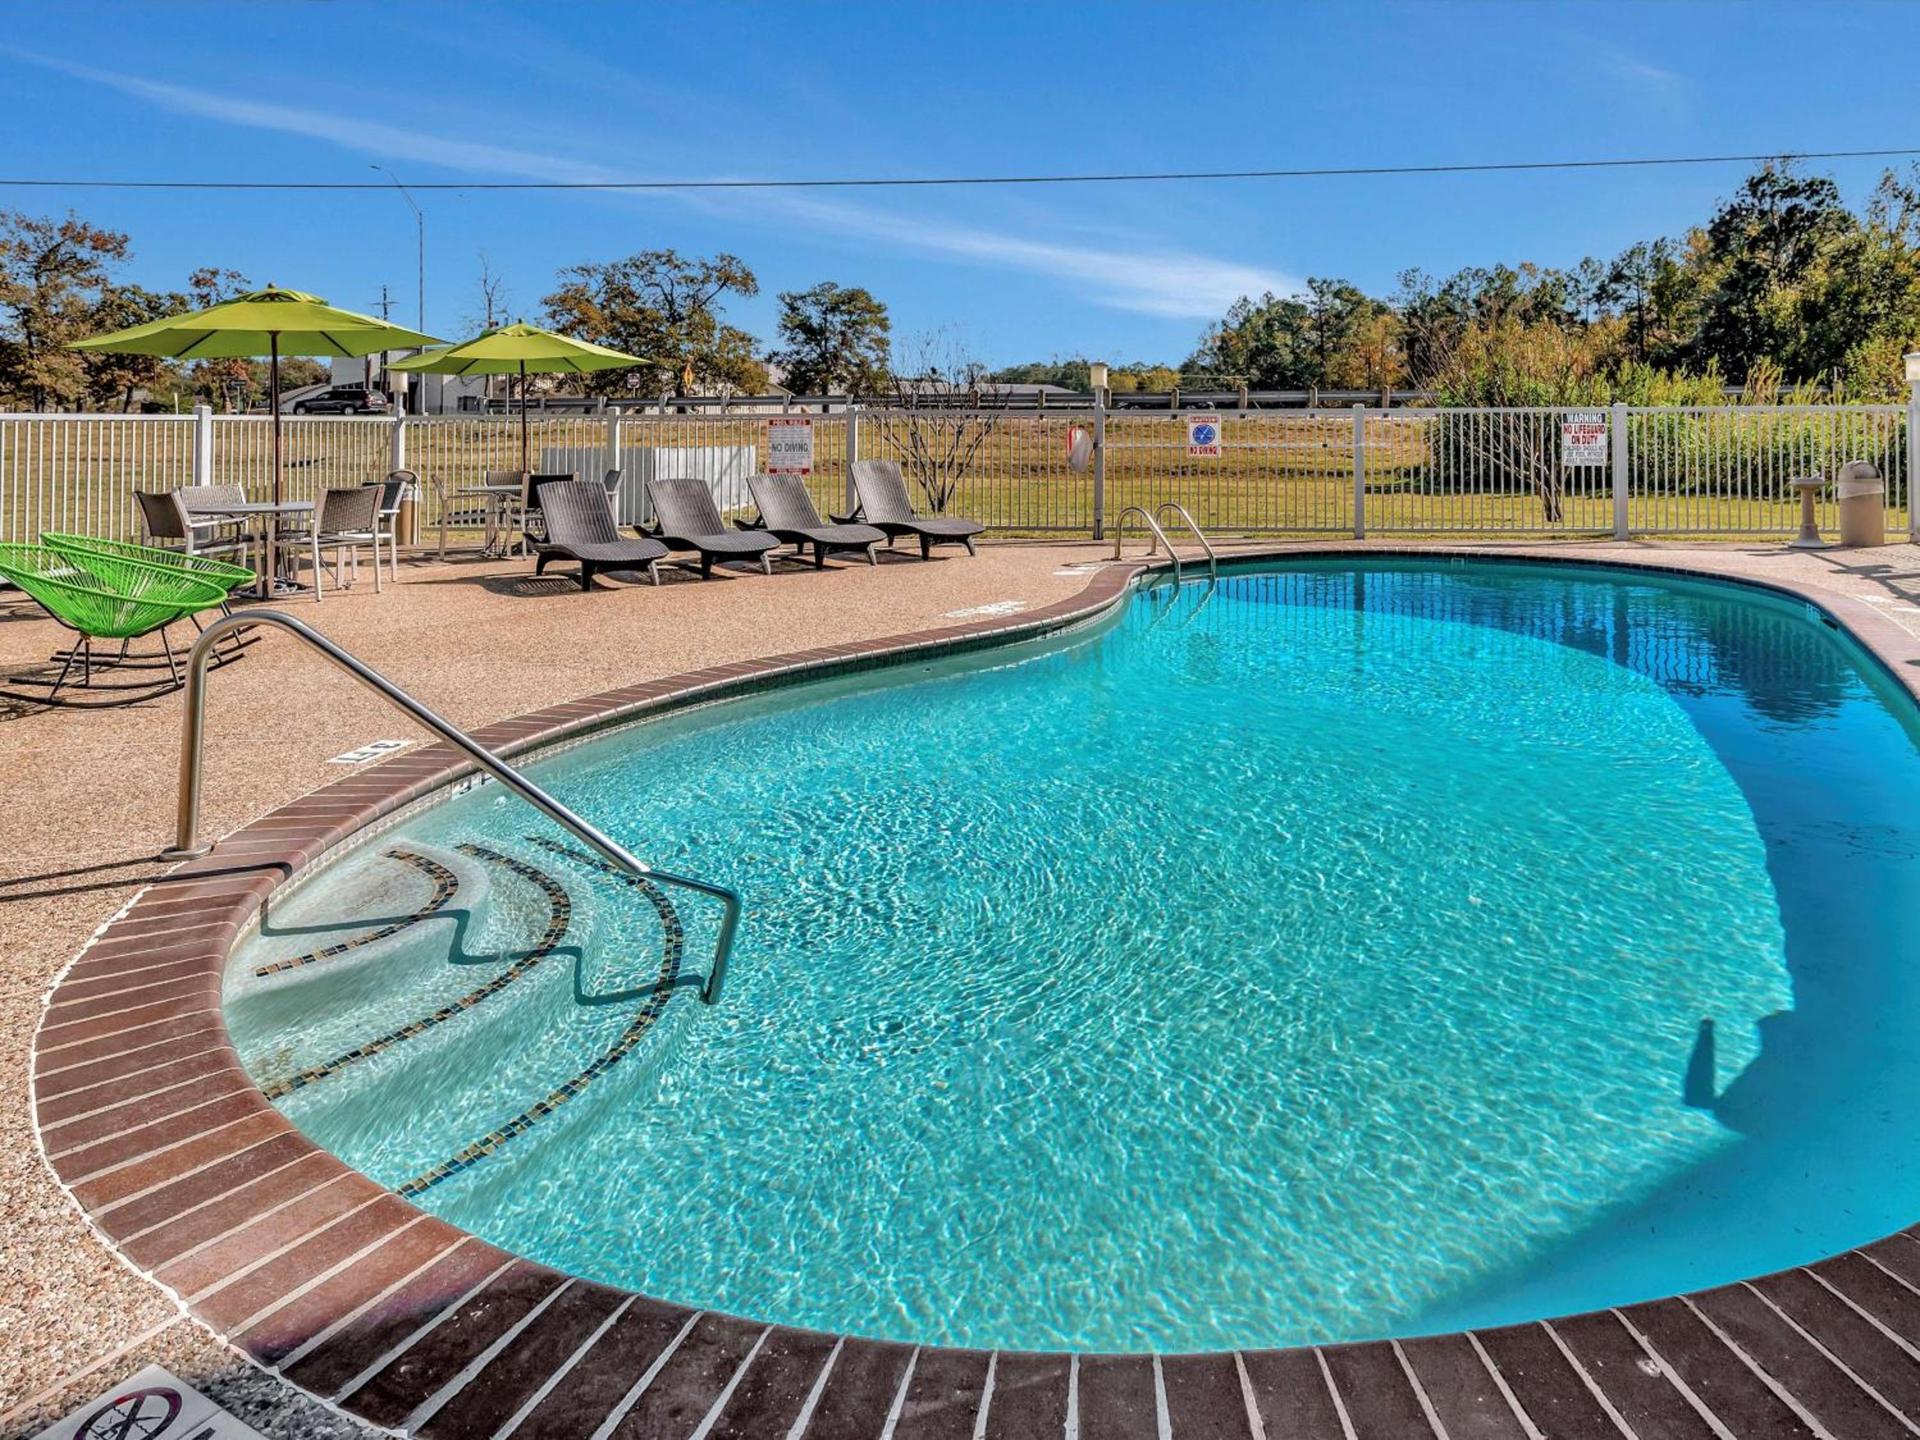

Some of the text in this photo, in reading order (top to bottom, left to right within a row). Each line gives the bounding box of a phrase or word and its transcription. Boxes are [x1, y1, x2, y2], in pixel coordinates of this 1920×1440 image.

[1567, 413, 1602, 423] WARNING
[1563, 424, 1605, 434] NO LIFEGUARD
[1571, 435, 1598, 444] ON DUTY
[771, 442, 808, 452] NO DIVING
[1190, 446, 1197, 455] NO
